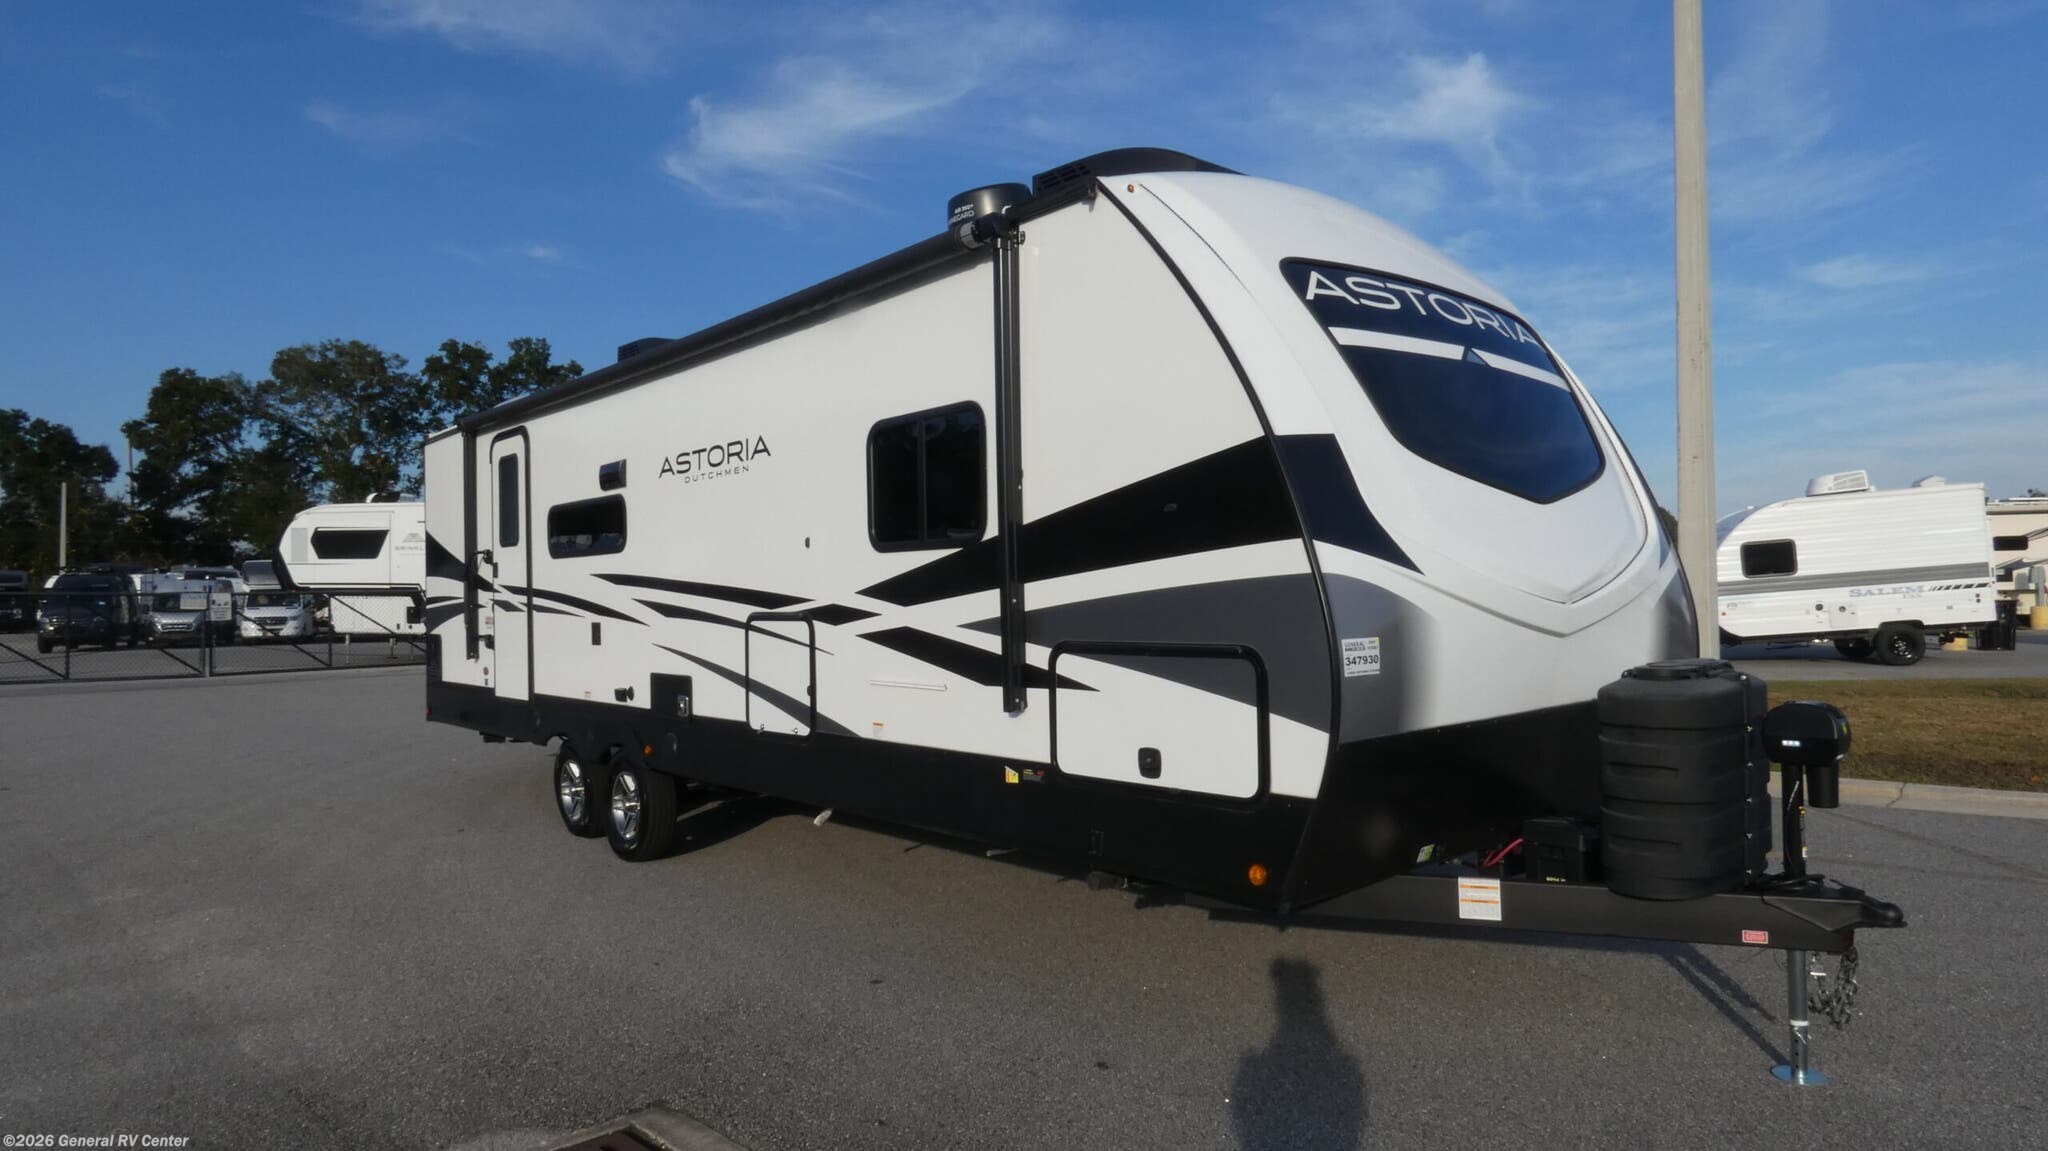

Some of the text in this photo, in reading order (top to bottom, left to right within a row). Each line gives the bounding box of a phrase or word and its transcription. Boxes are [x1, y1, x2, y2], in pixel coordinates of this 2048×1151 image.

[1305, 270, 1538, 344] ASTORIA
[658, 435, 771, 478] ASTORIA
[684, 466, 749, 483] DUTCHMEN
[1849, 585, 1923, 597] SALEM
[1345, 654, 1379, 666] 347930
